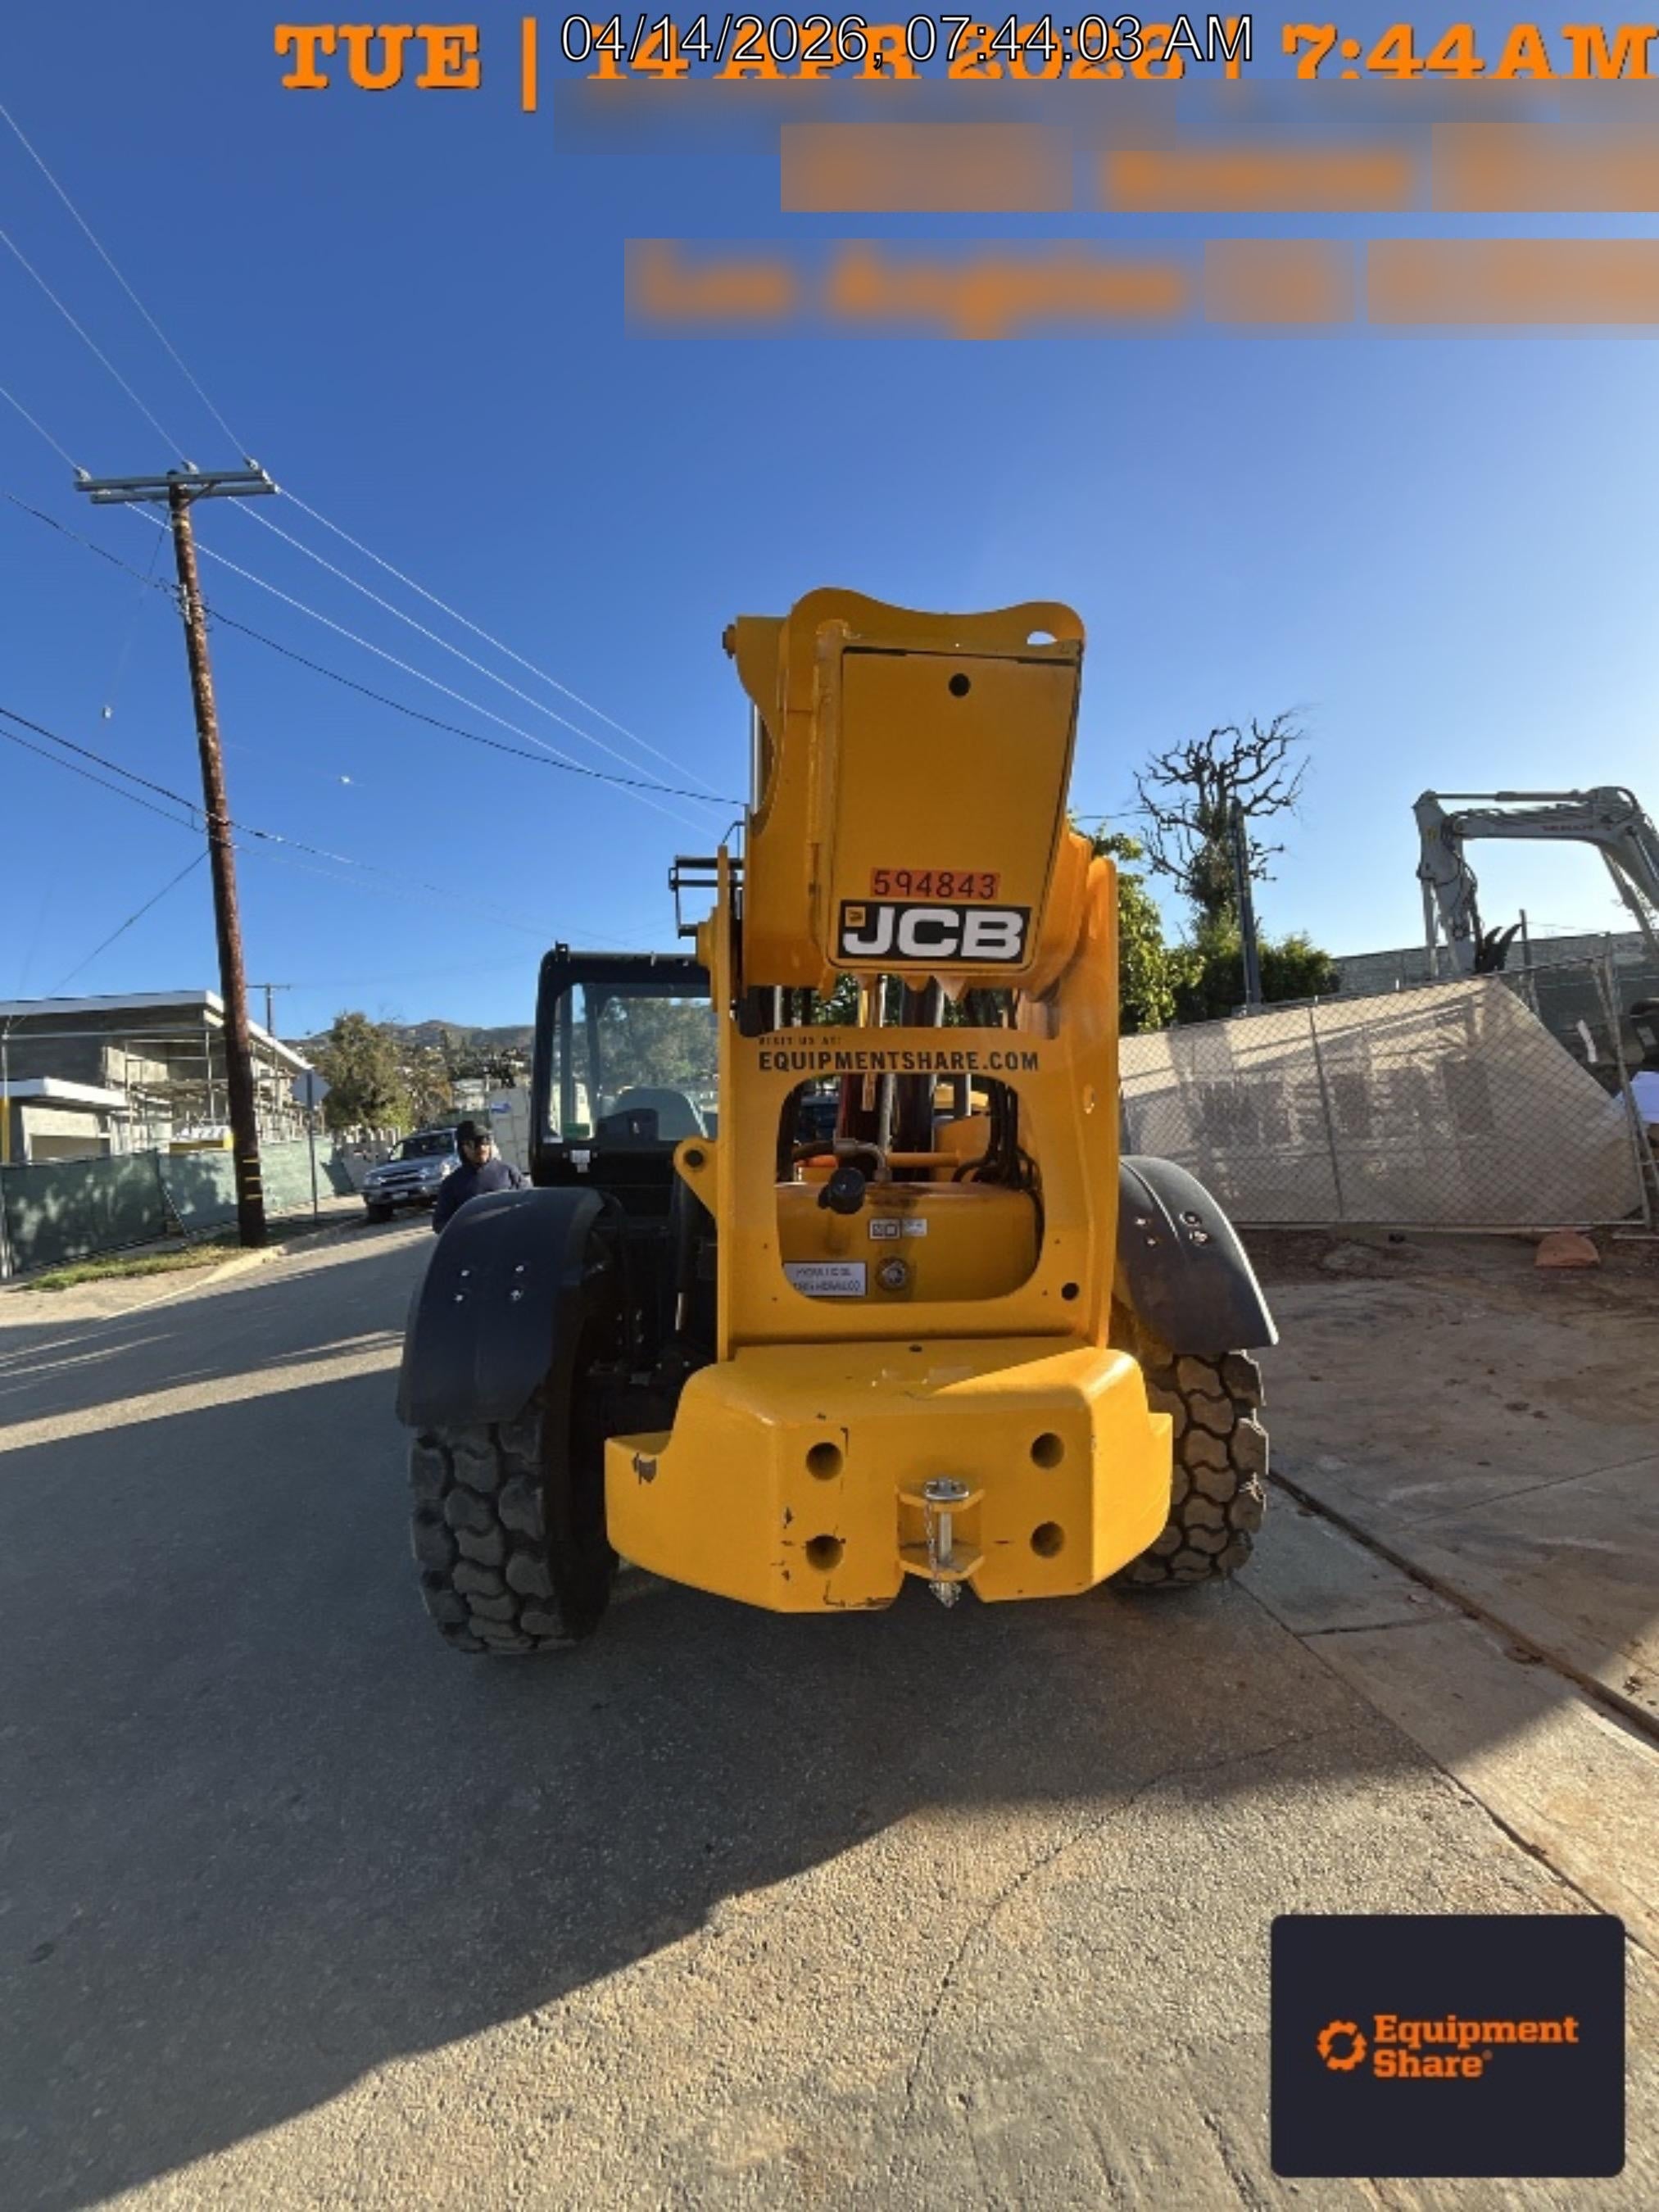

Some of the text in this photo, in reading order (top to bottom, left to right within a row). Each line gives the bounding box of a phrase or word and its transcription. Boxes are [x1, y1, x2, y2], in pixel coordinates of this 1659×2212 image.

[873, 869, 996, 899] 594843
[842, 906, 1024, 959] JCB
[759, 1050, 1040, 1072] EQUIPMENTSHARE.COM
